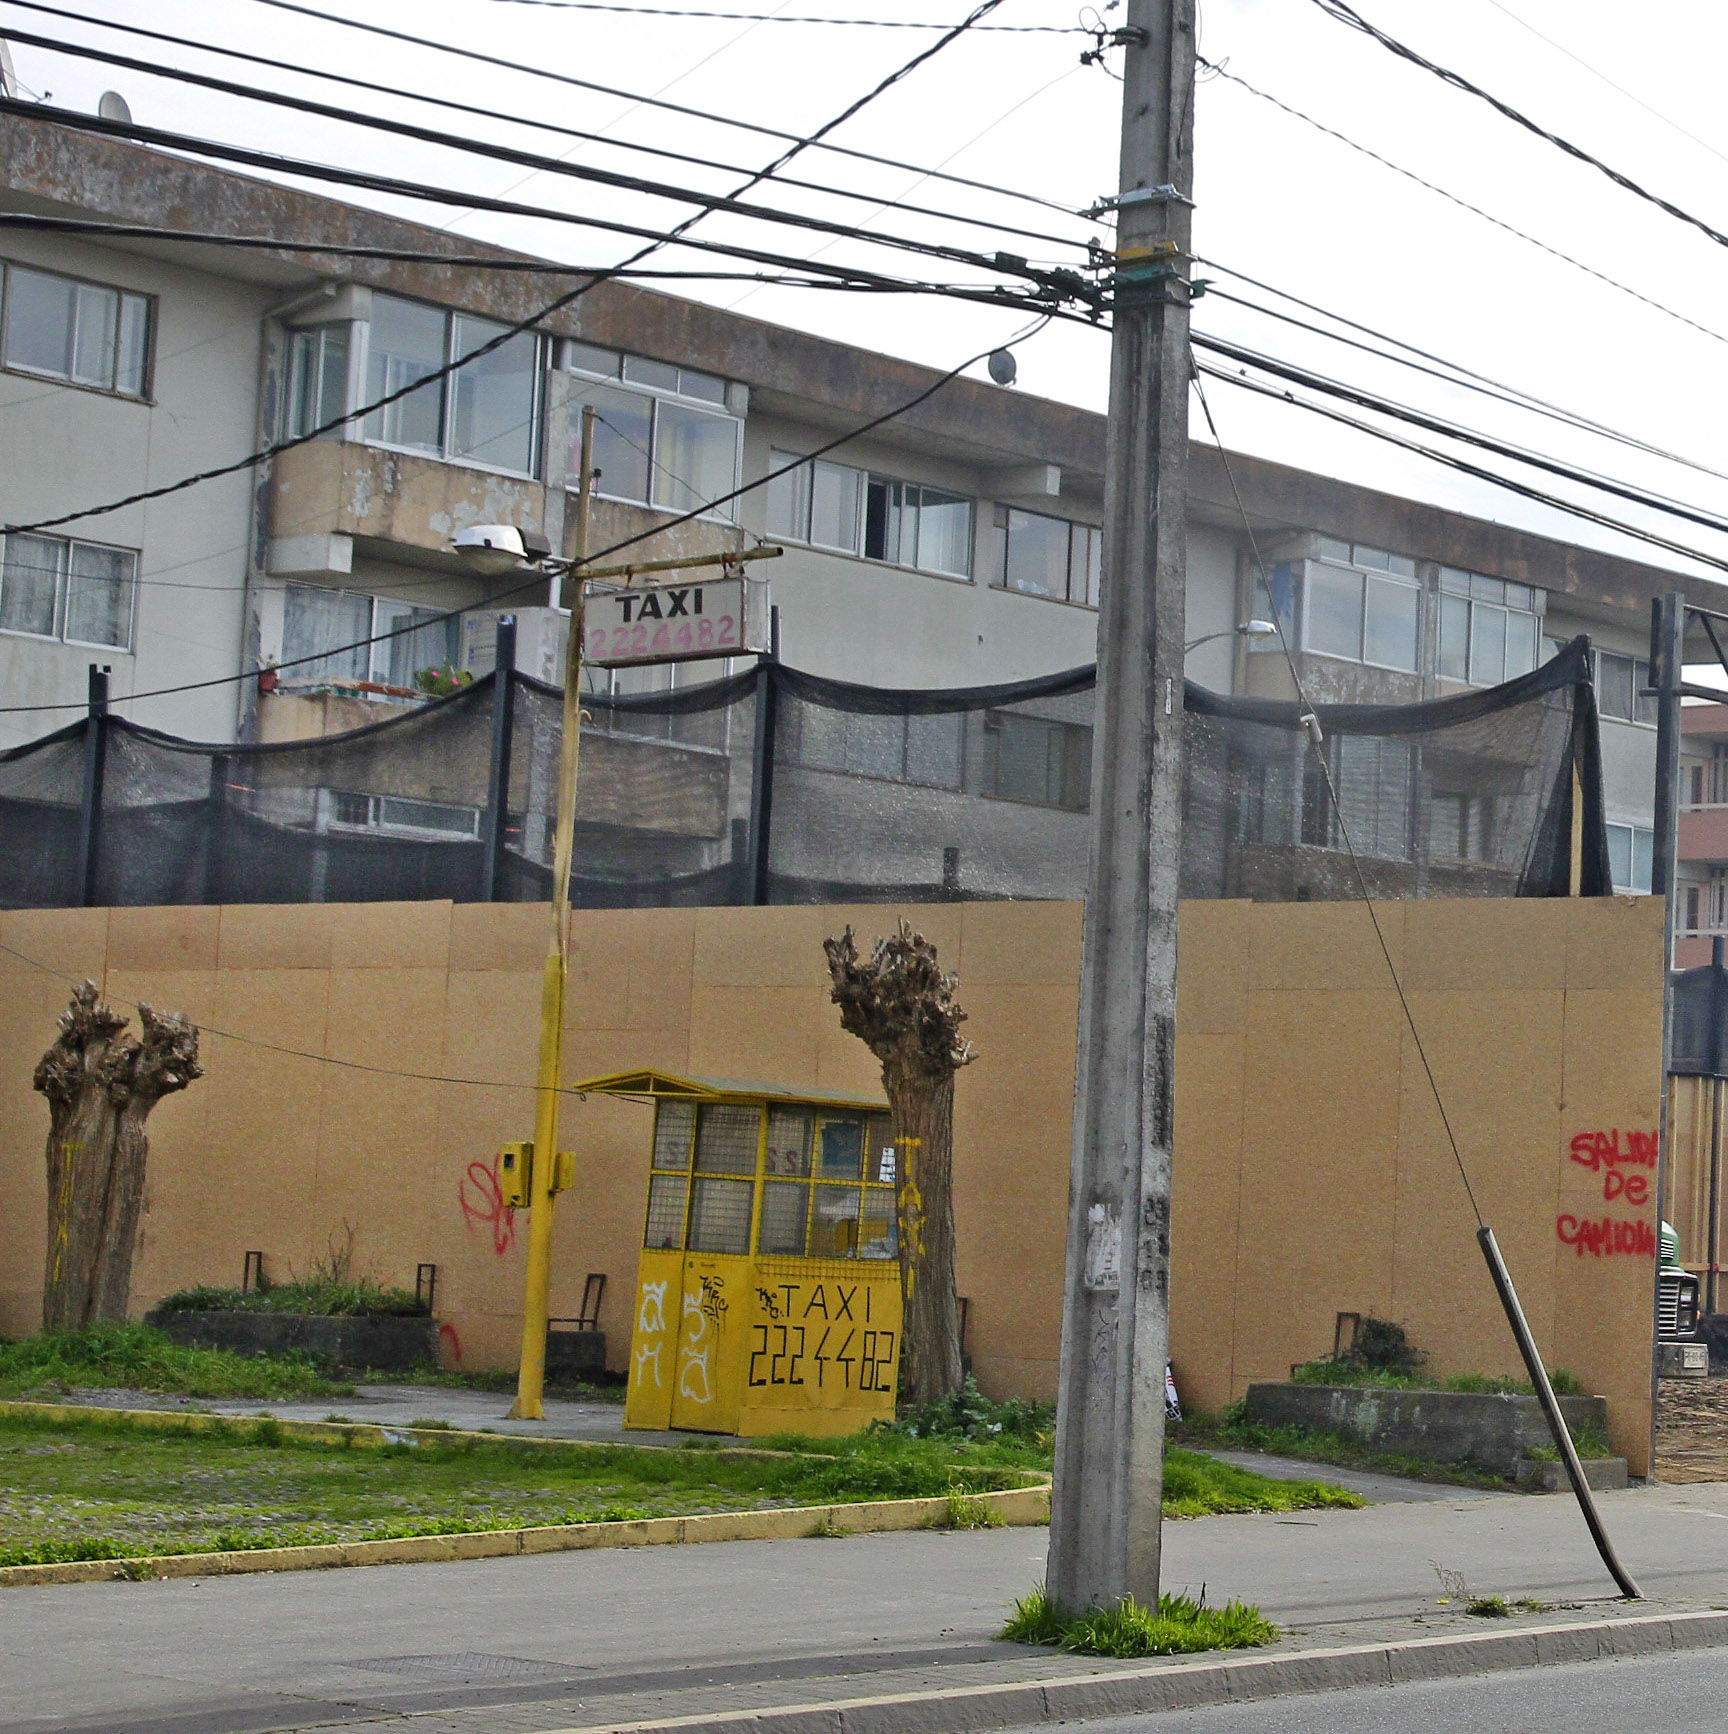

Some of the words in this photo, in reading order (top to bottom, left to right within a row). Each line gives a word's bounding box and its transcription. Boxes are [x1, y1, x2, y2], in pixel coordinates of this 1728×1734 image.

[615, 588, 703, 622] TAXI
[590, 614, 736, 660] 2224482
[778, 1284, 871, 1323] TAXI
[748, 1325, 895, 1392] 2224482
